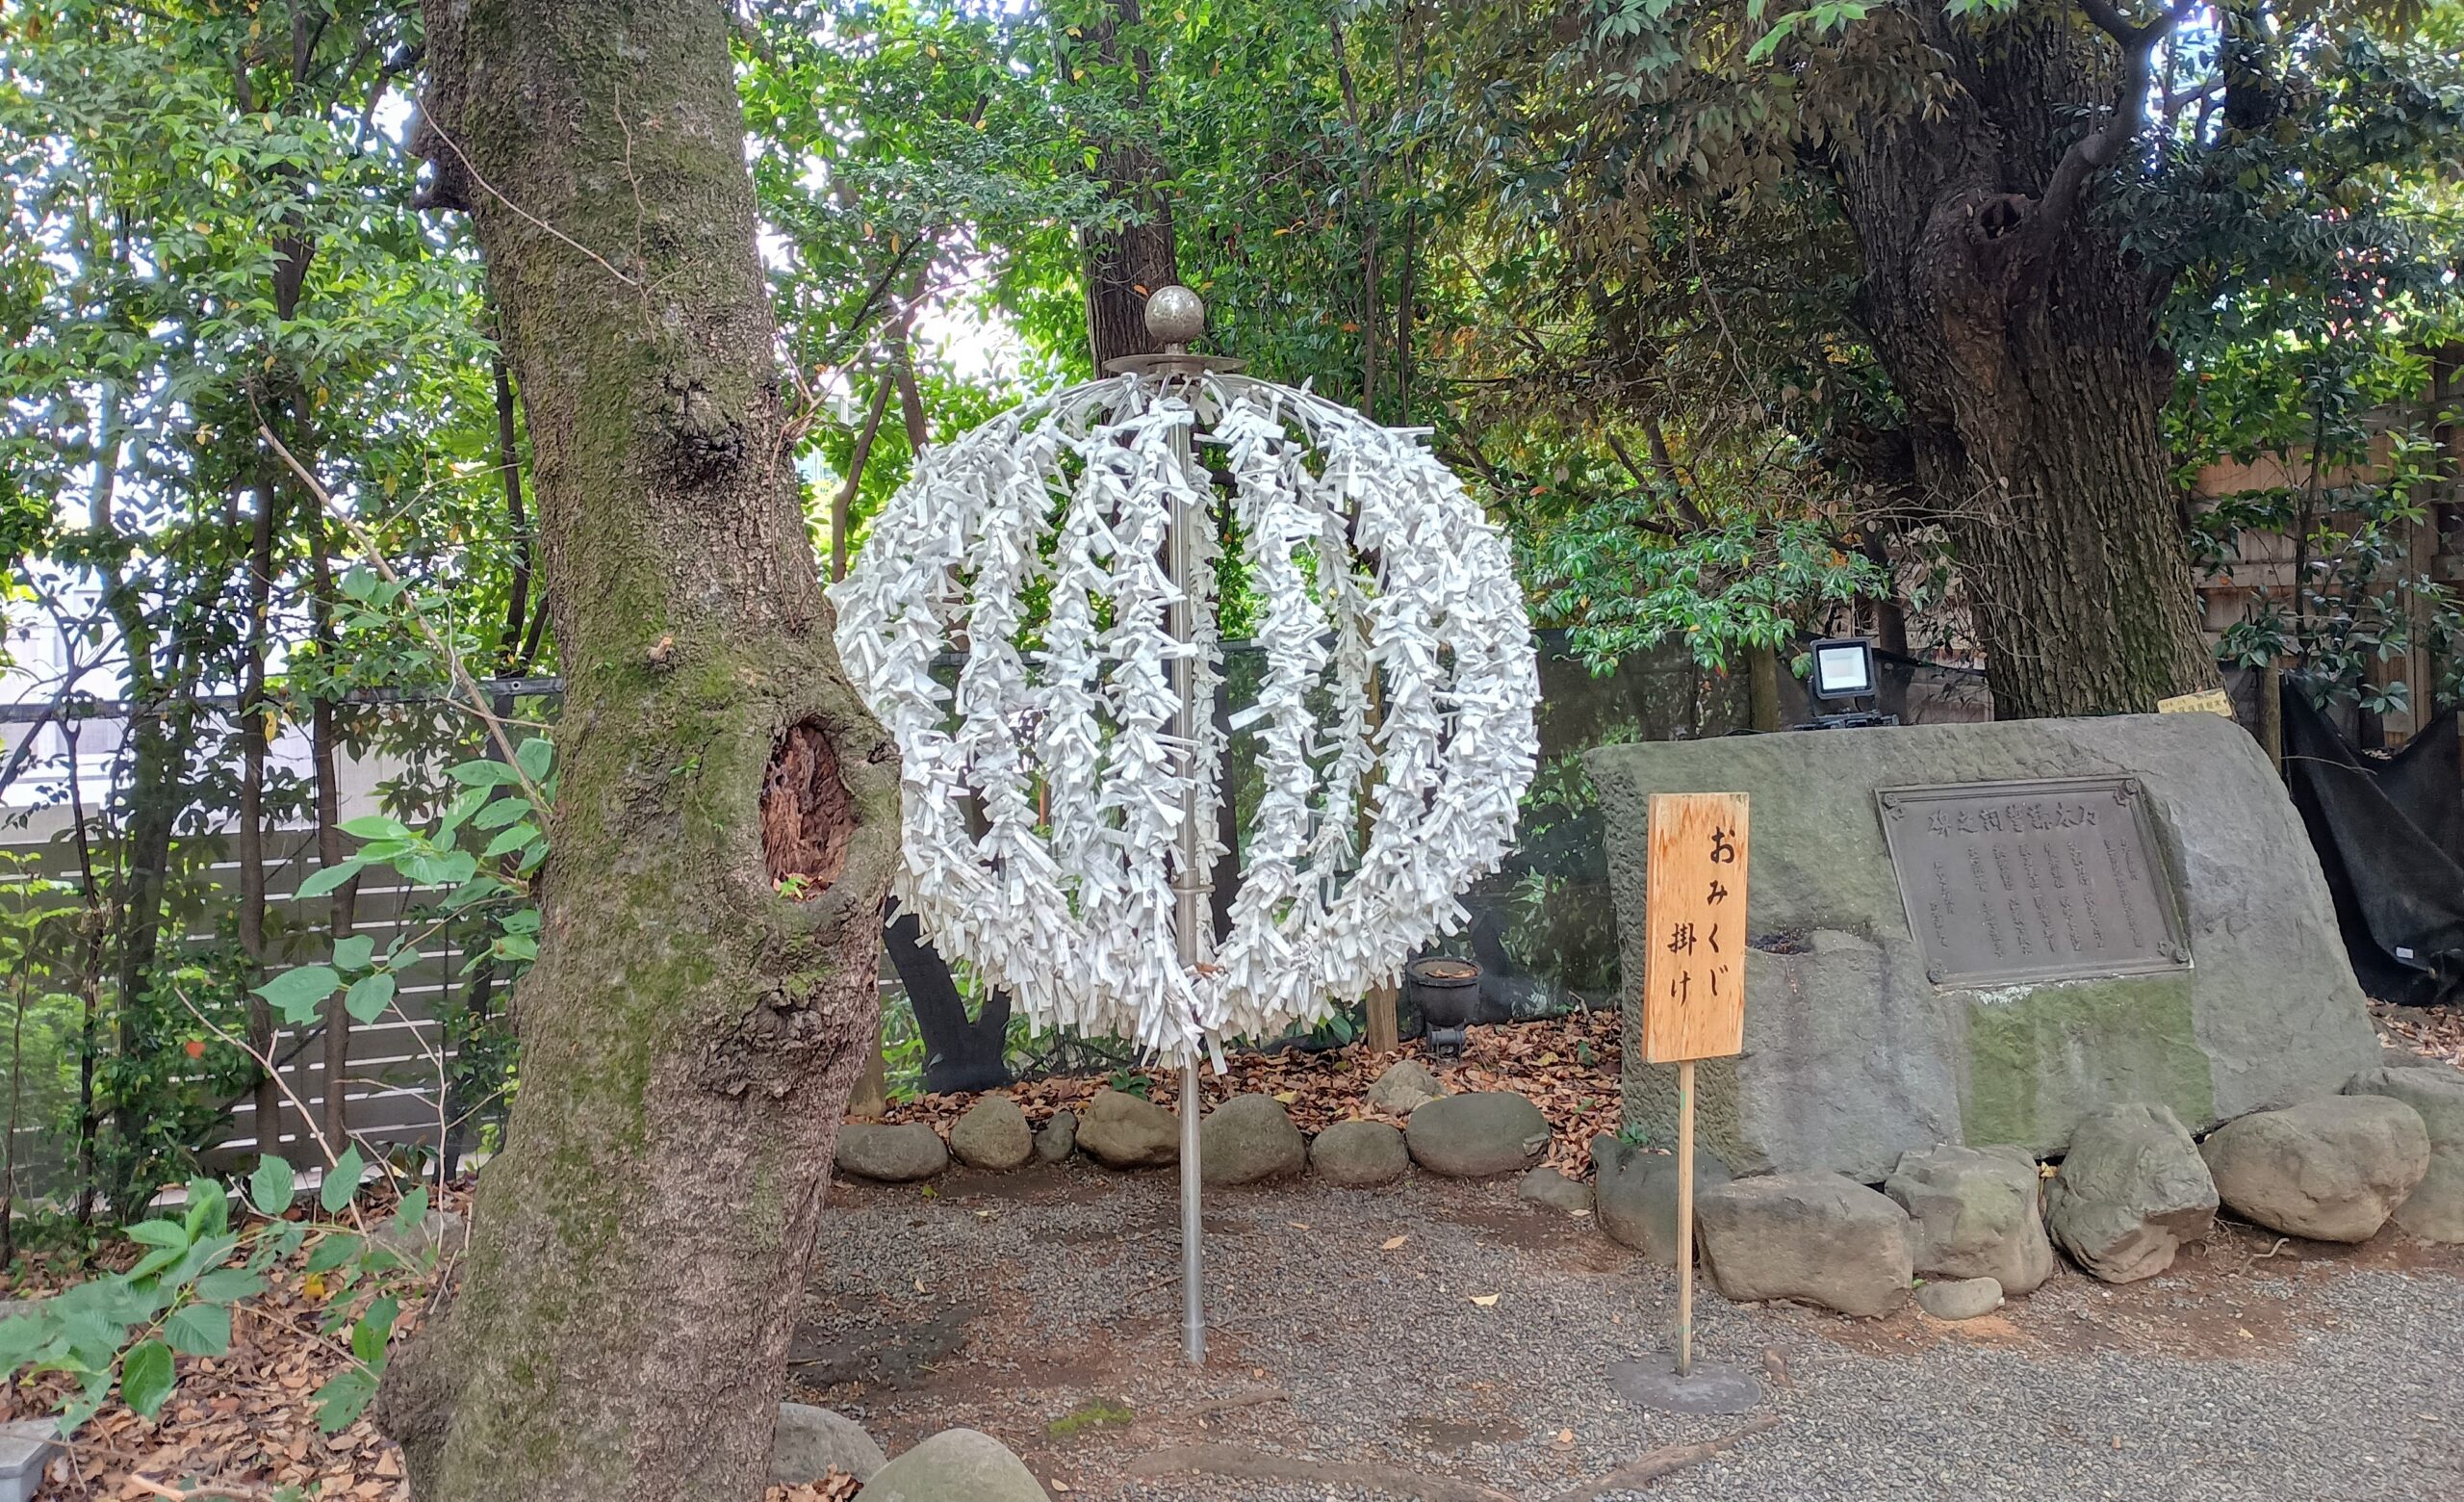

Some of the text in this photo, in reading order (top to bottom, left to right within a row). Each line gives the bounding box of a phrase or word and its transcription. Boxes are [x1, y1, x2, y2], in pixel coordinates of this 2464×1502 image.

[1667, 922, 1697, 1006] 掛け
[1707, 826, 1735, 997] おみくじ
